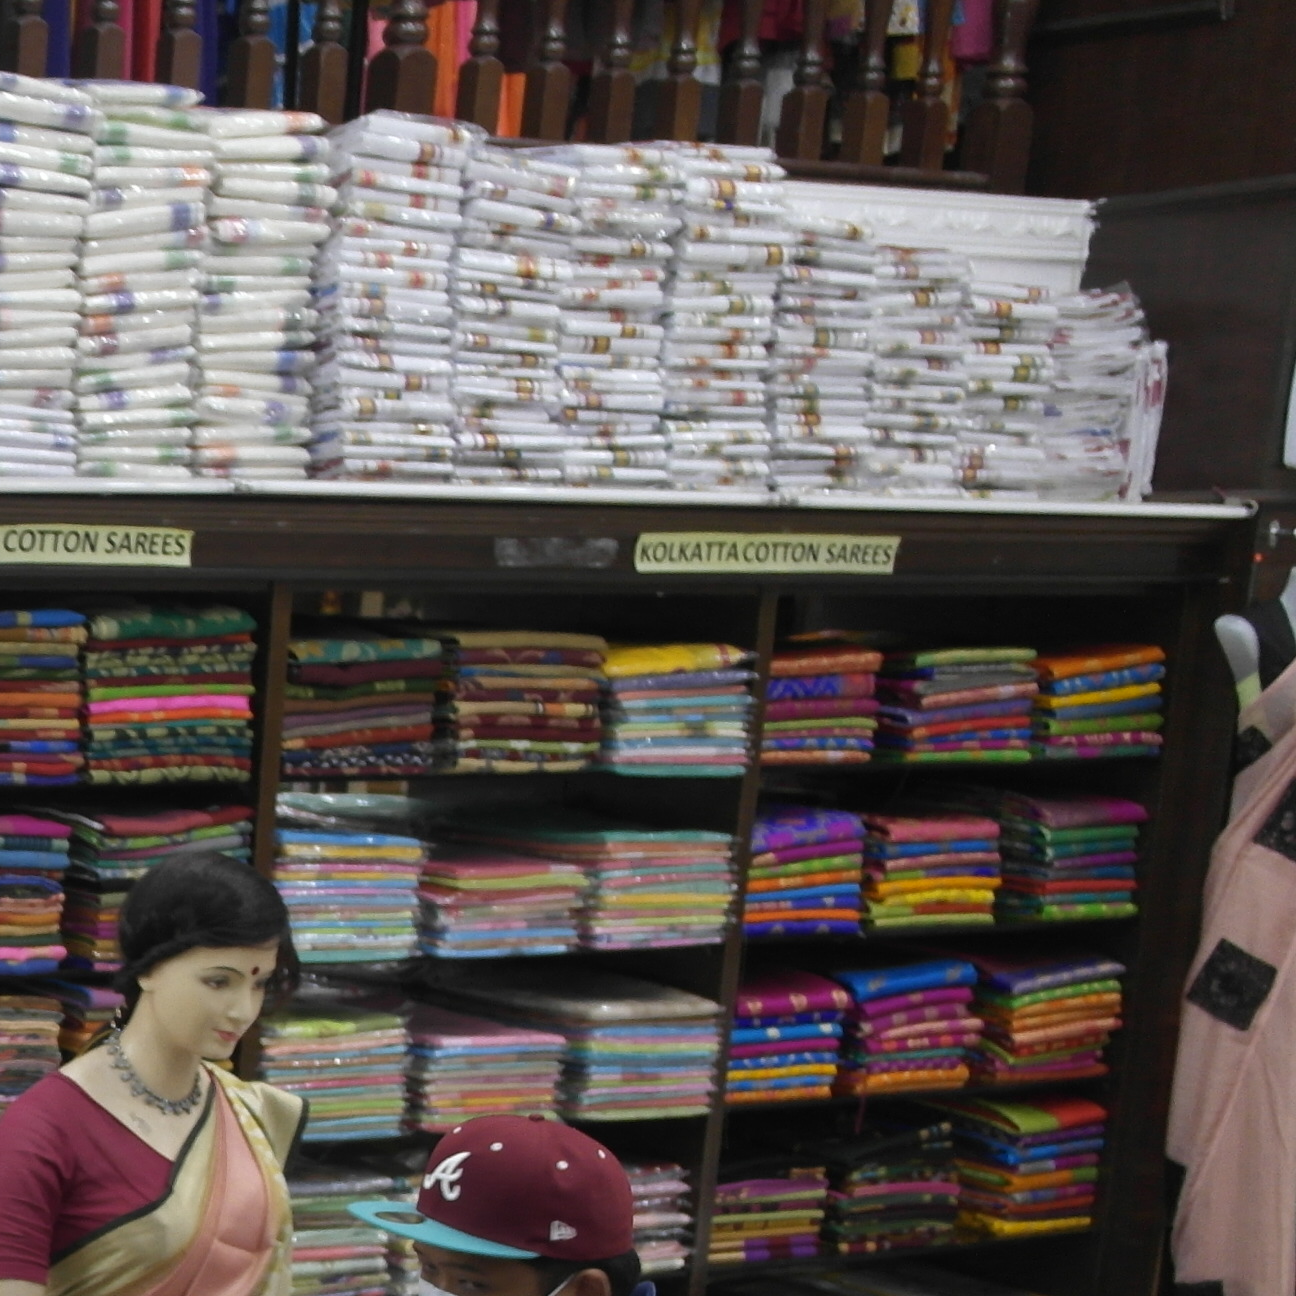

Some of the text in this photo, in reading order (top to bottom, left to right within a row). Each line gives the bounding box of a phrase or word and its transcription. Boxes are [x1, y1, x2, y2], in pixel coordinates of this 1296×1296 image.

[3, 529, 99, 554] COTTON
[104, 531, 186, 556] SAREES
[640, 541, 892, 565] KOLKATTA COTTON SAREES
[423, 1151, 471, 1201] A
